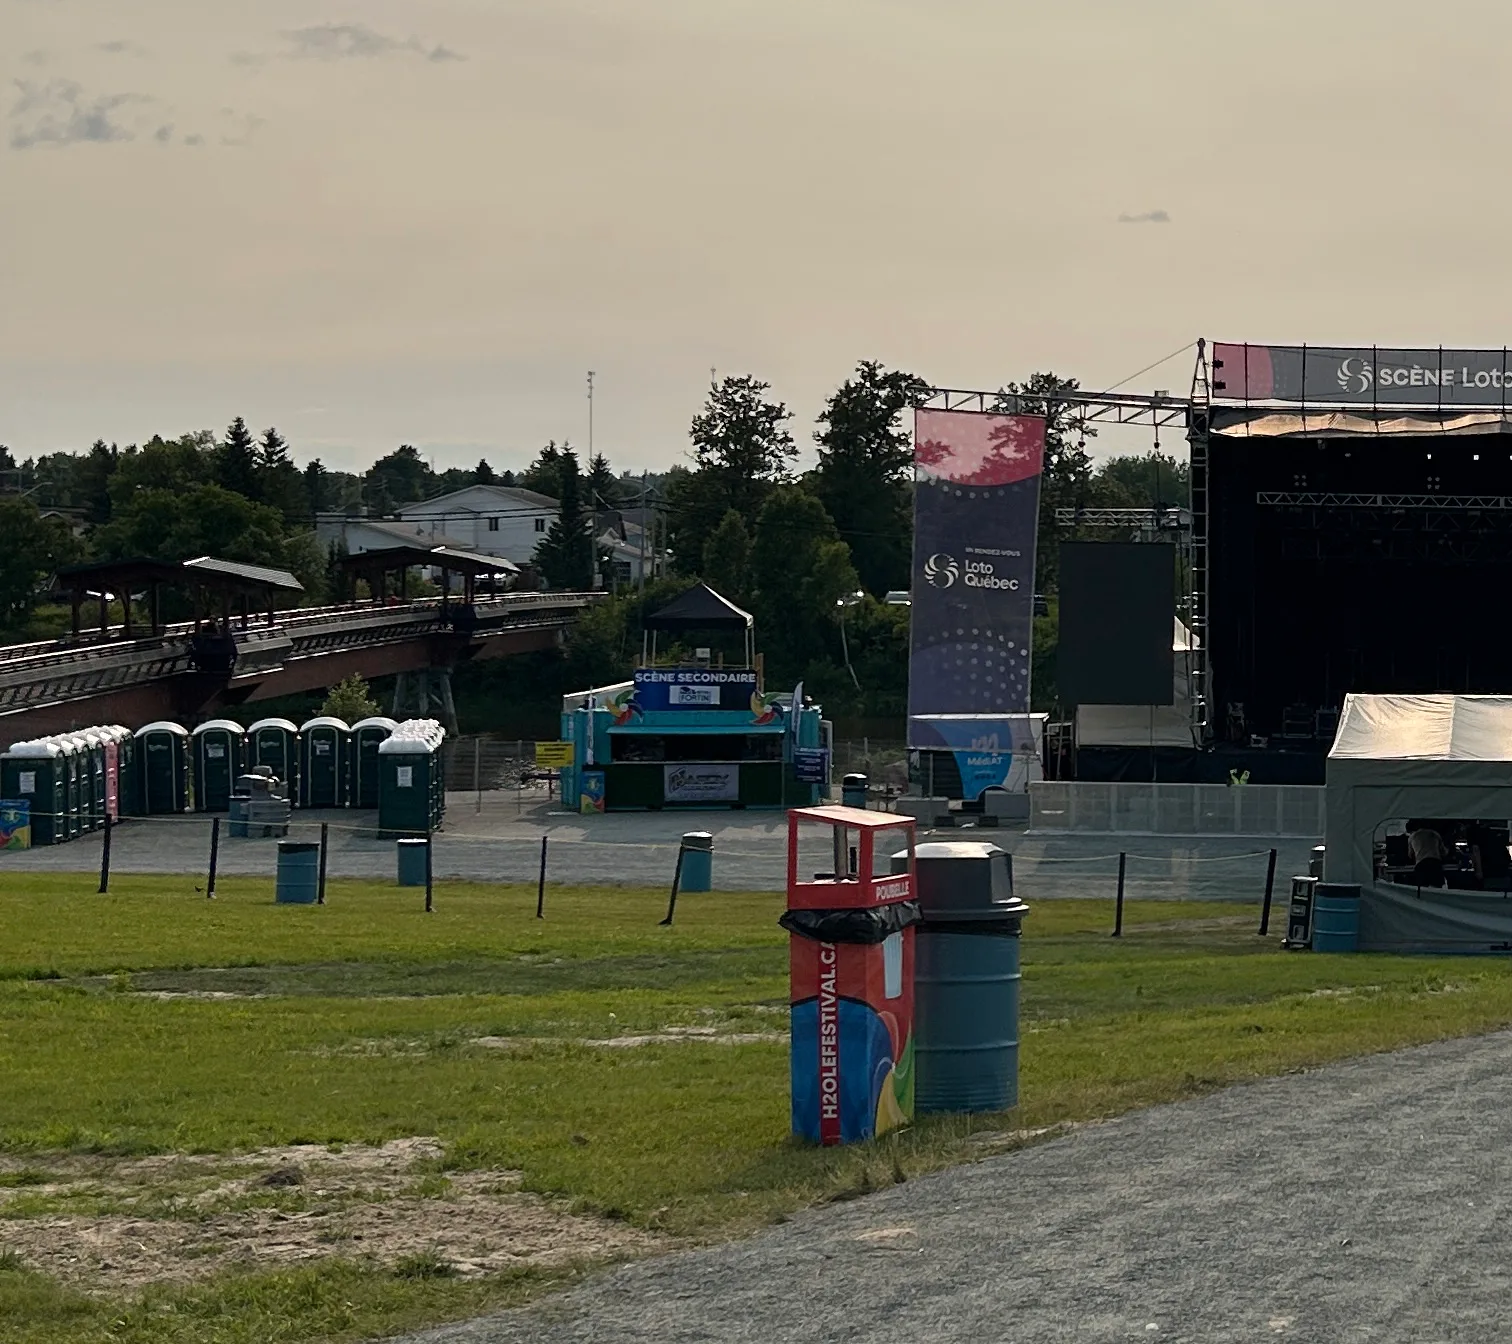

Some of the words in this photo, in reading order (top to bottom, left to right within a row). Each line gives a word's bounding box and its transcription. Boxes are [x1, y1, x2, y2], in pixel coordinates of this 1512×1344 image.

[1379, 364, 1454, 387] SCÈNE
[965, 560, 993, 574] Loto
[965, 574, 1019, 590] Québec
[635, 671, 676, 683] SCÈNE
[677, 673, 756, 683] SECONDAIRE
[876, 881, 910, 901] POUBELLE
